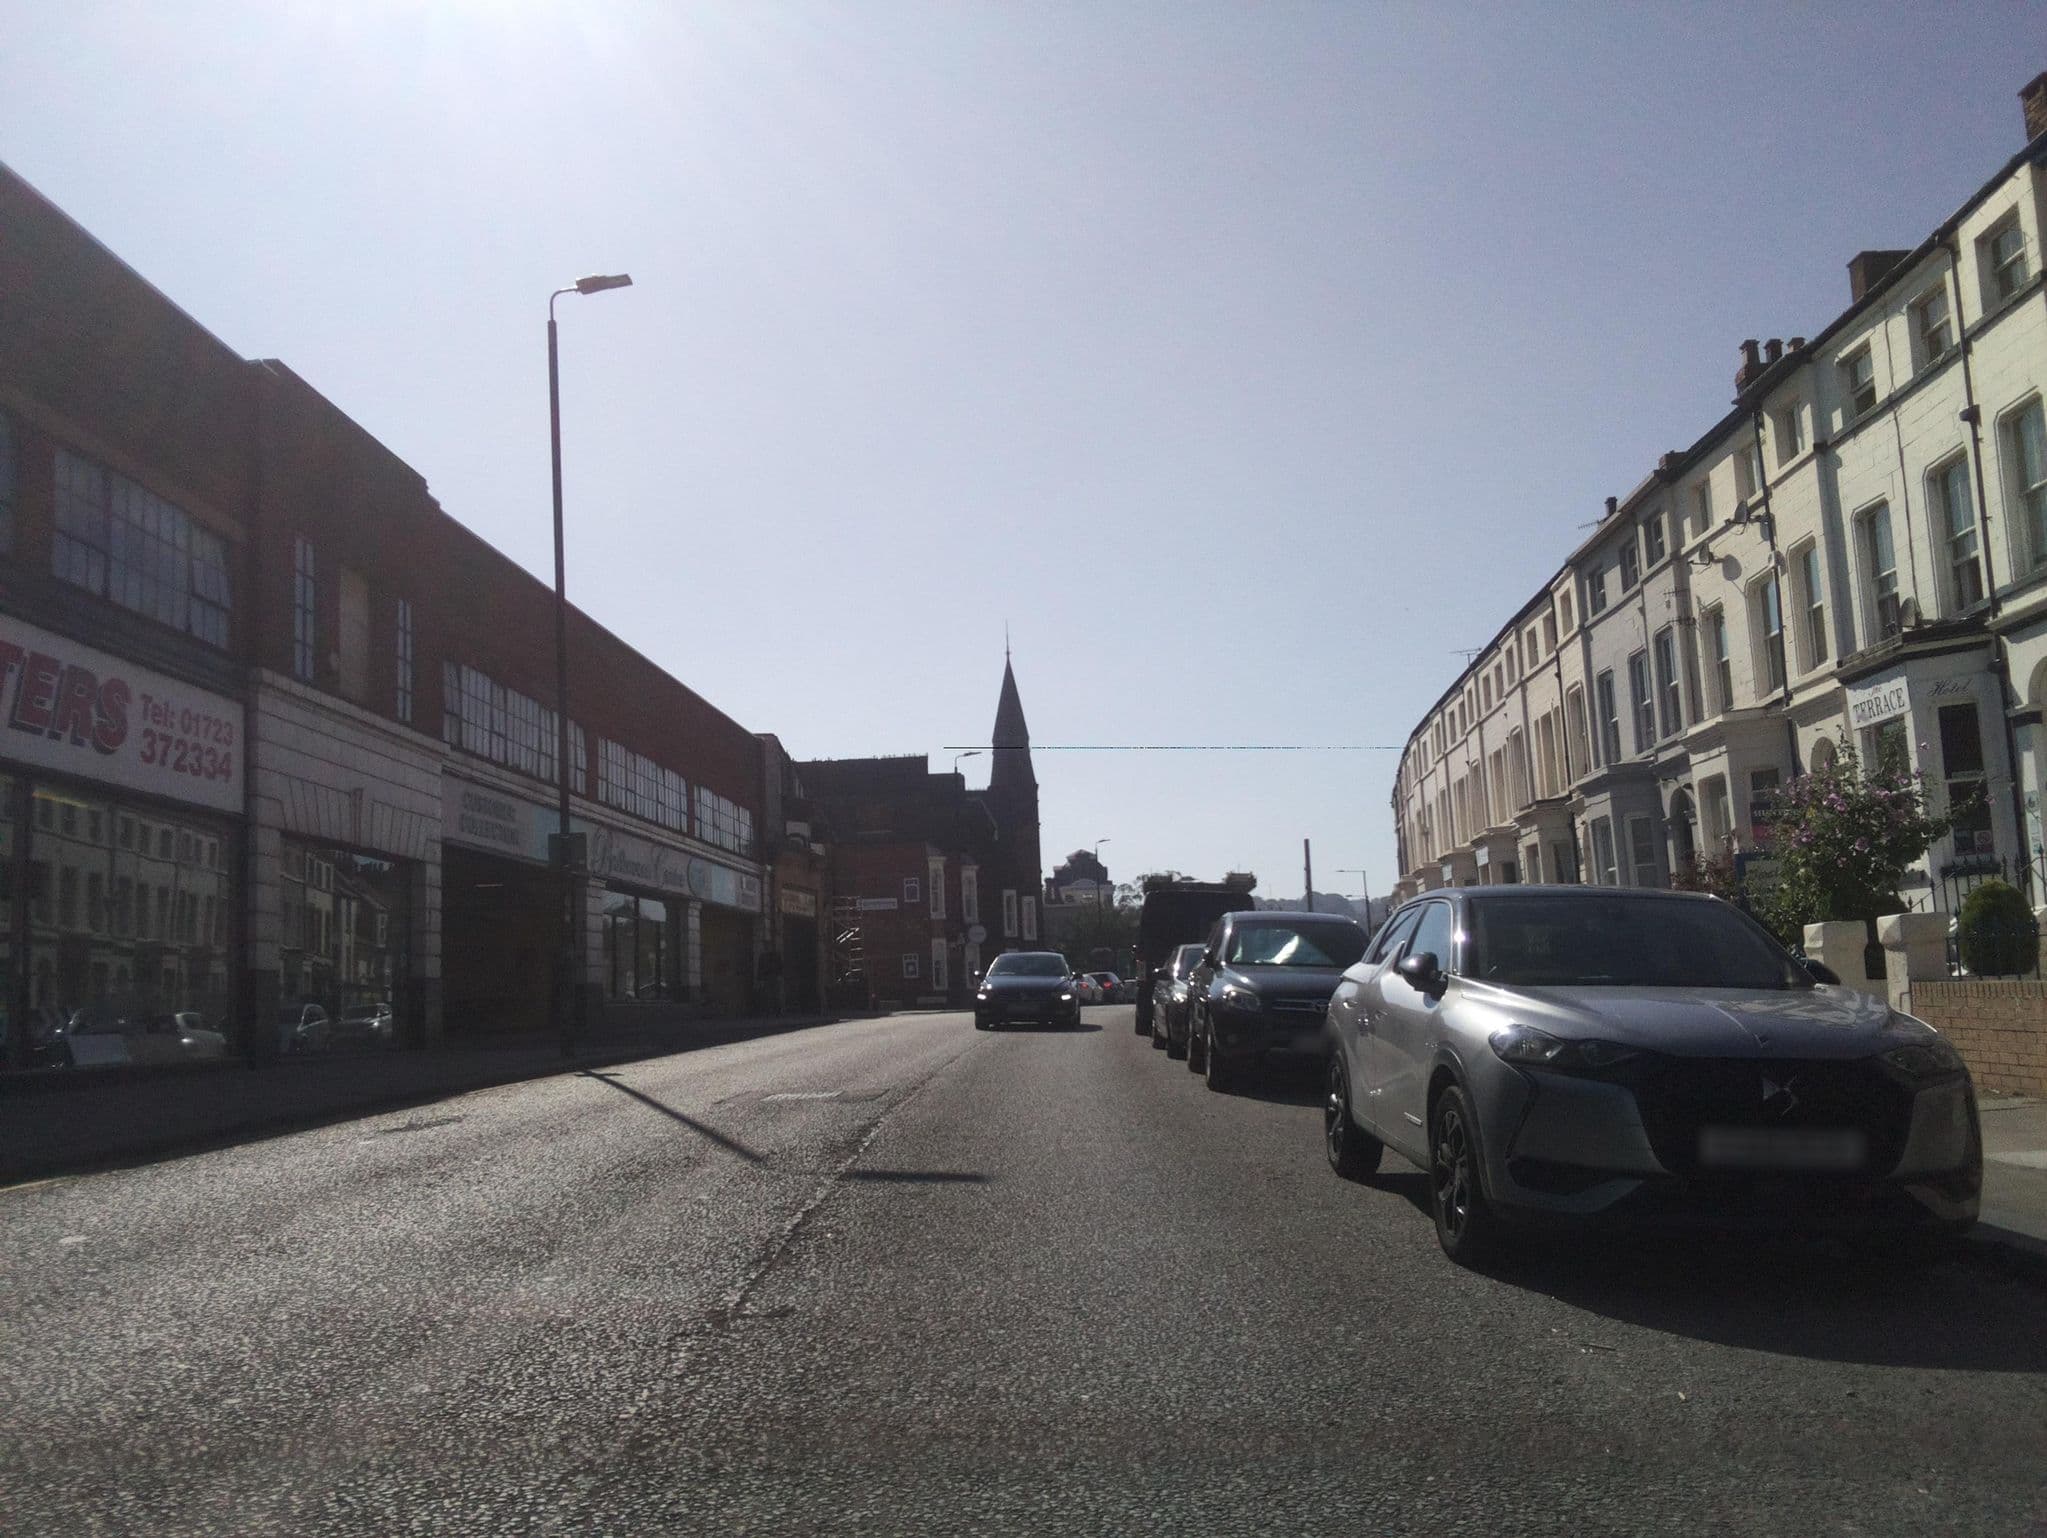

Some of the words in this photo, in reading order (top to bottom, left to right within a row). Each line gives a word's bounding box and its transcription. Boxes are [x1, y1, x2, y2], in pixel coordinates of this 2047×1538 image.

[1853, 687, 1906, 722] TERRACE
[1927, 679, 1973, 697] Hotel
[141, 693, 175, 728] Tel:
[181, 708, 233, 746] 01723
[140, 728, 232, 783] 372334
